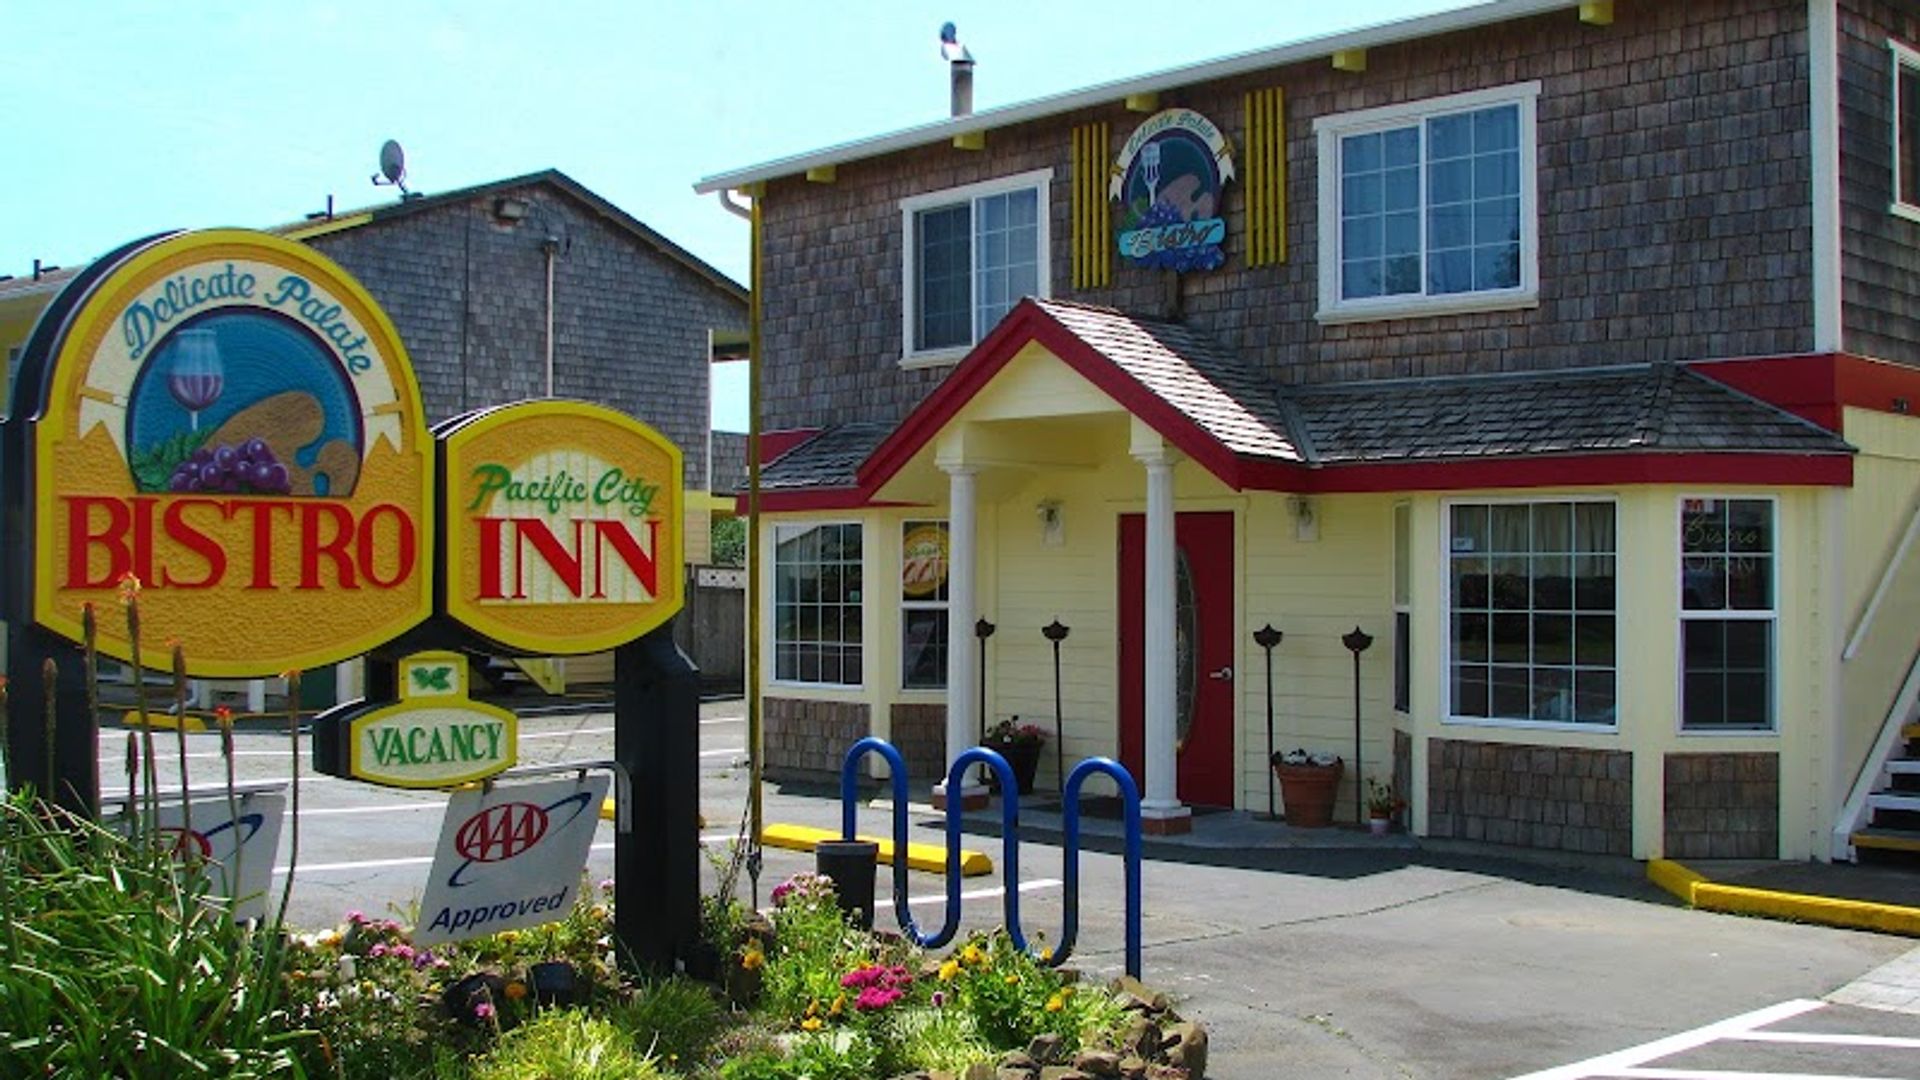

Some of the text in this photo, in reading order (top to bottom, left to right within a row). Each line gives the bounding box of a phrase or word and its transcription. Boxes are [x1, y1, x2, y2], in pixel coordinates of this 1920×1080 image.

[123, 263, 373, 378] Delicate Palate
[469, 463, 662, 518] Pacific City
[62, 496, 416, 590] BISTRO
[478, 517, 660, 600] INN
[367, 723, 502, 766] VACANCY
[461, 803, 543, 861] AAA
[428, 886, 568, 934] Approved
